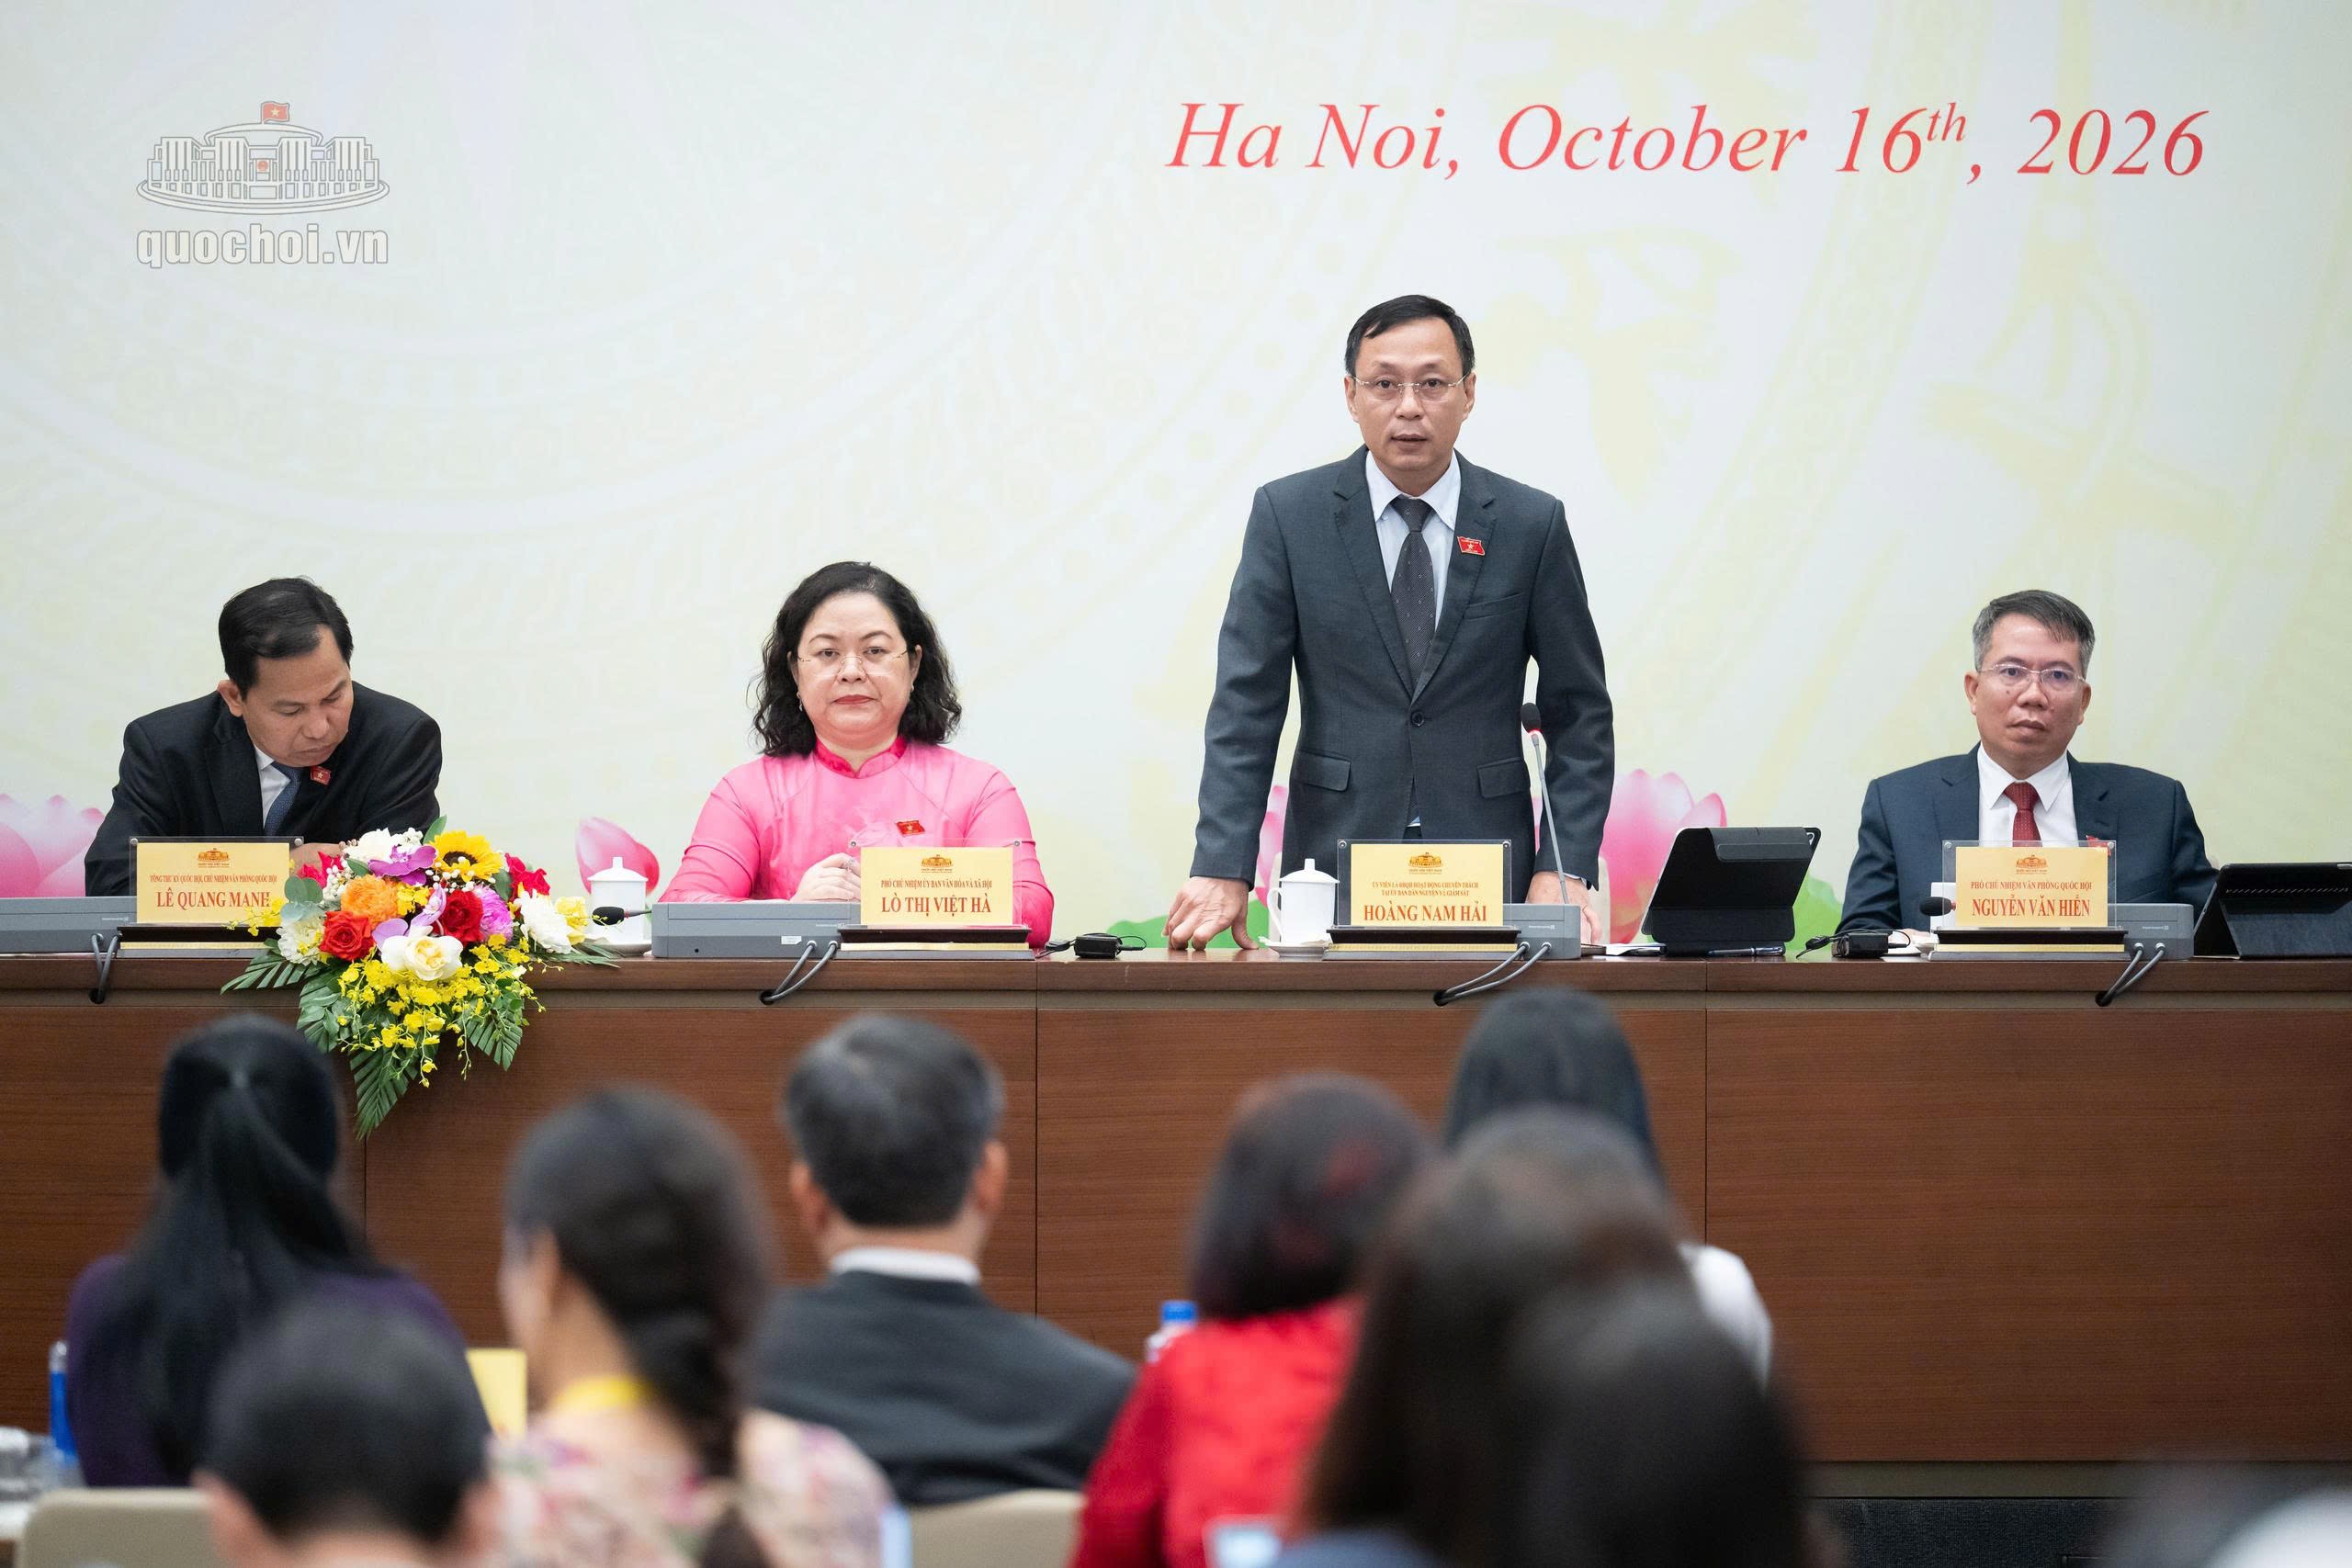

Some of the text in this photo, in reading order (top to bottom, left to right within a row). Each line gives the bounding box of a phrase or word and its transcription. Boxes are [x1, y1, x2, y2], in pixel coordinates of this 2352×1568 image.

[1167, 102, 1283, 169] Ha
[1308, 104, 1460, 178] Noi,
[1498, 104, 1809, 173] October
[2017, 108, 2207, 176] 2026
[156, 887, 174, 908] LÊ
[177, 891, 226, 910] QUANG
[882, 893, 991, 917] LÒ THỊ VIỆT HÀ
[1972, 894, 2026, 916] NGUYỄN
[2029, 896, 2055, 916] VĂN
[1364, 900, 1487, 921] HOÀNG NAM HẢI
